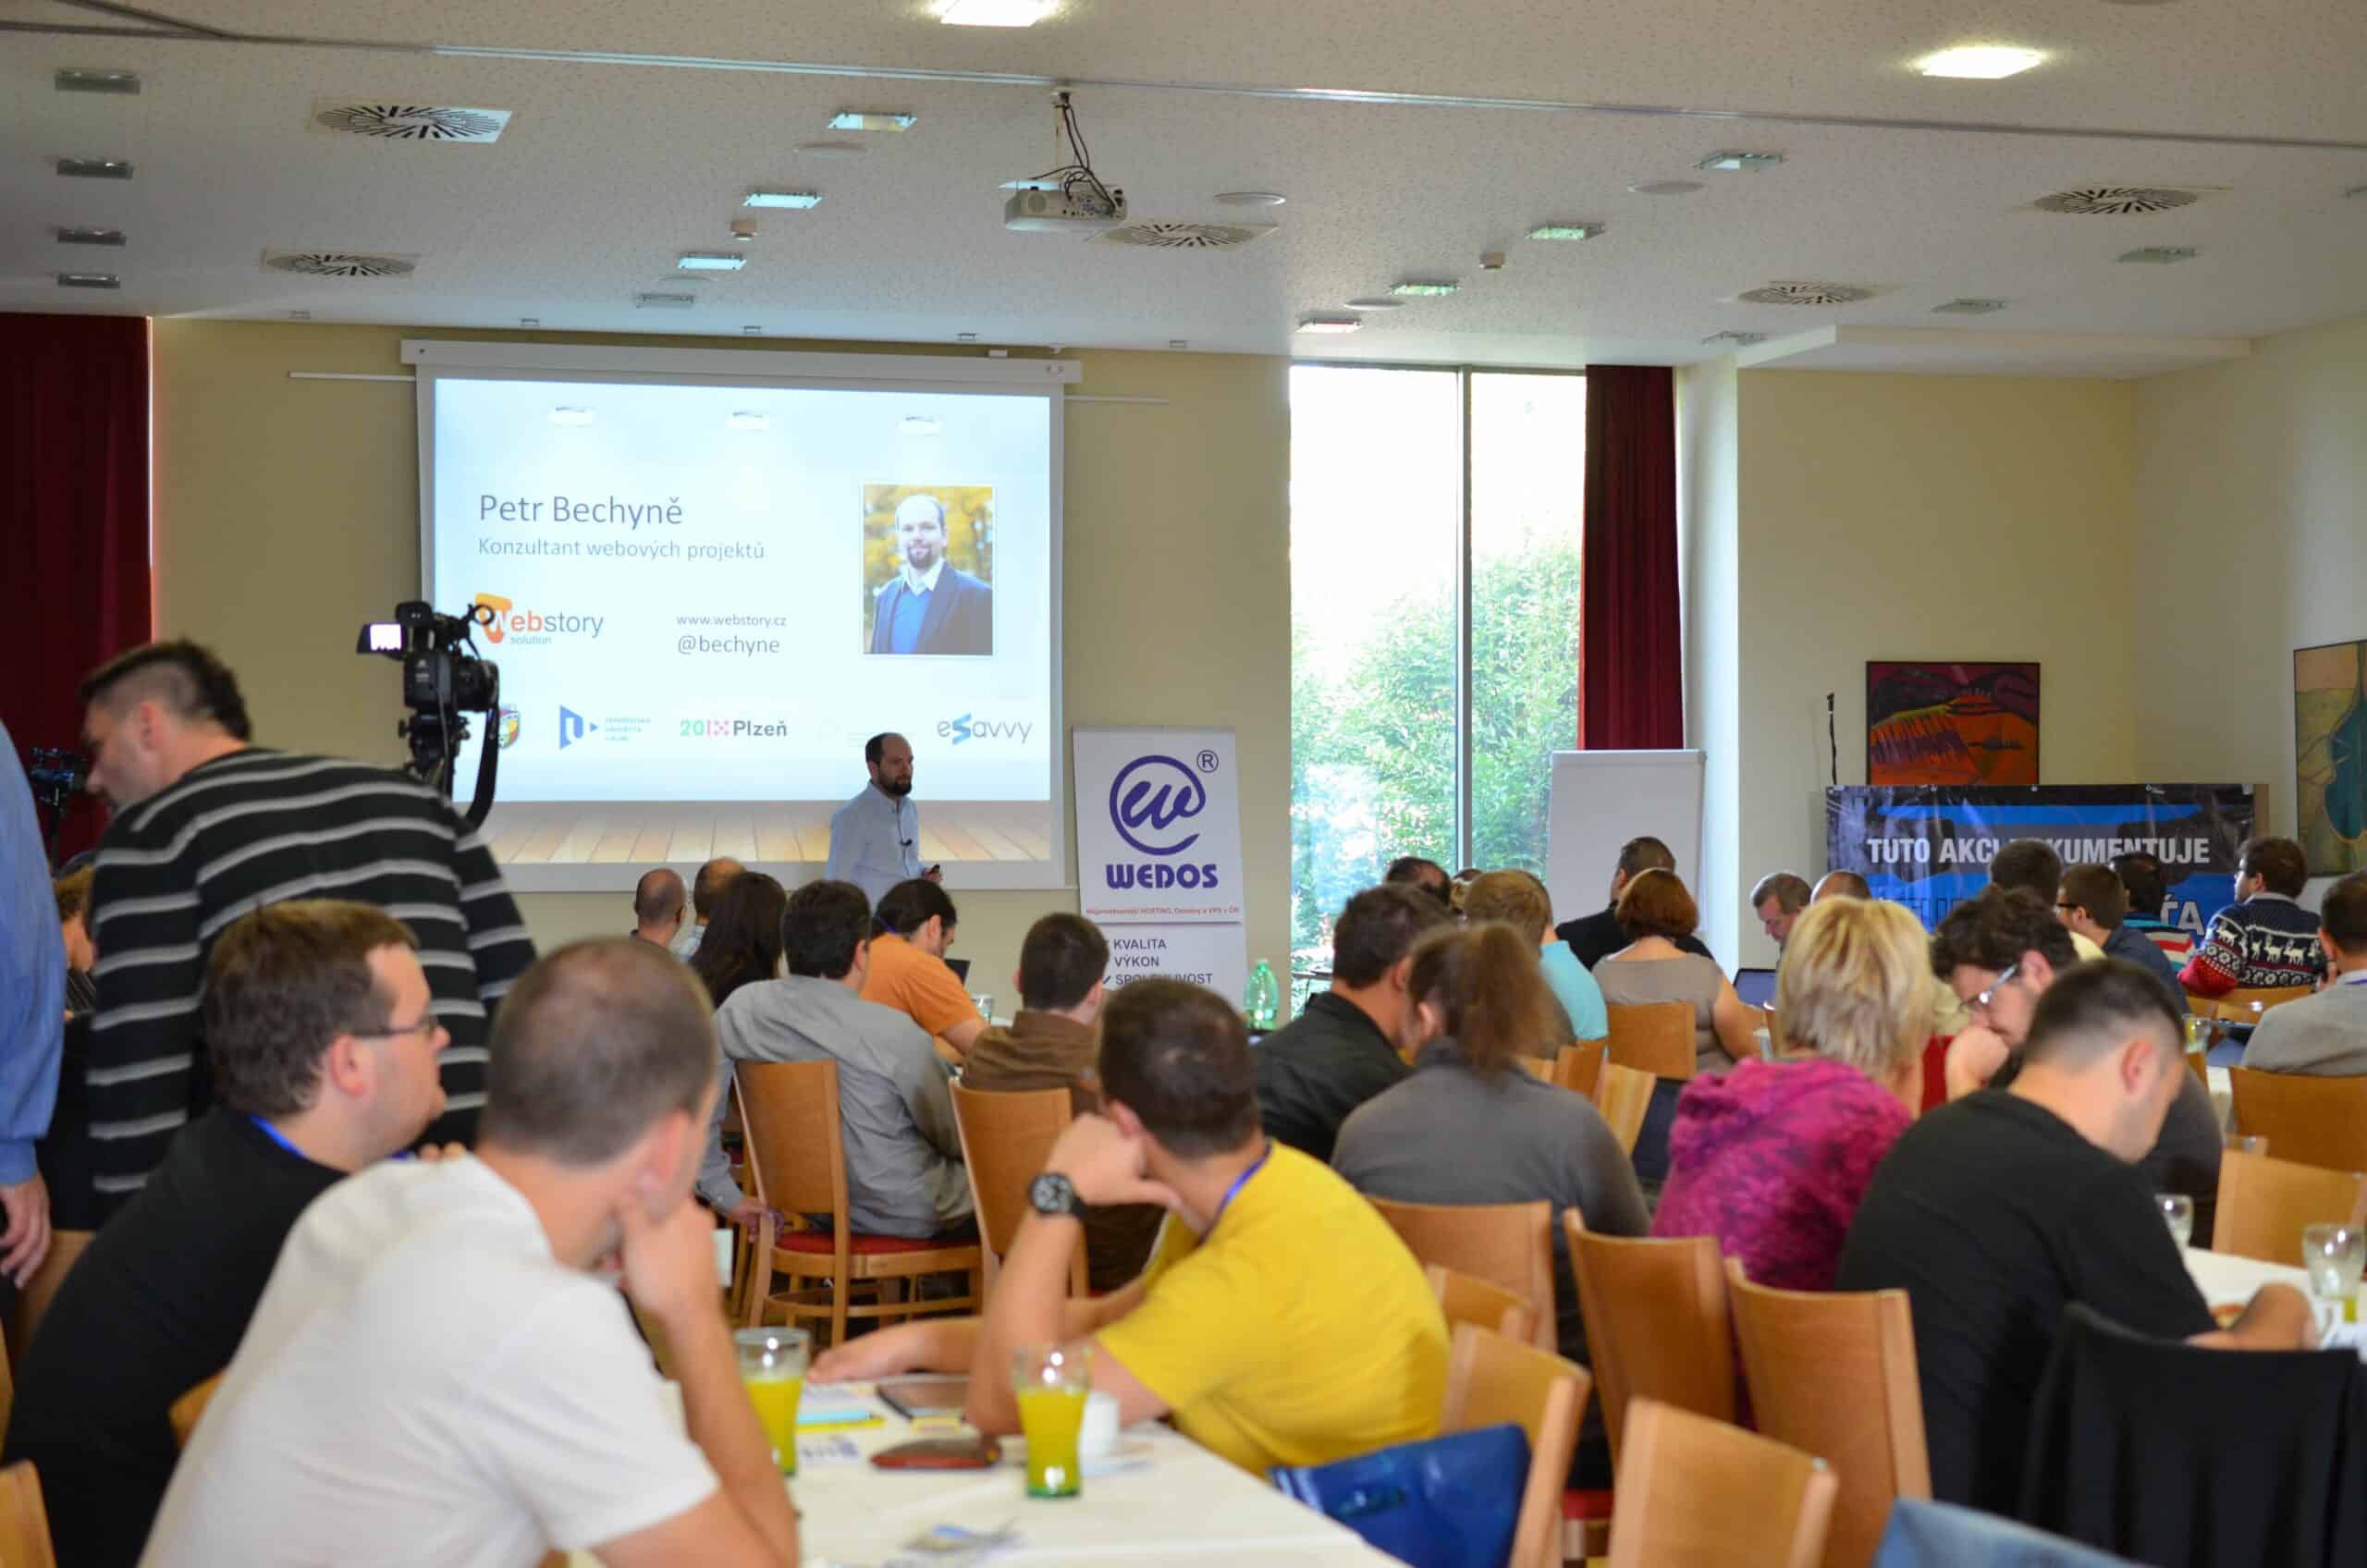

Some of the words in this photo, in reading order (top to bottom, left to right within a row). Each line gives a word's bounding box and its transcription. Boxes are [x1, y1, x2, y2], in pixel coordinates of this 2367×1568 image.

[480, 495, 544, 521] Petr
[553, 496, 682, 530] Bechyně
[478, 538, 581, 556] Konzultant
[586, 539, 681, 560] webových
[687, 541, 765, 562] projektů
[676, 614, 787, 628] www.webstory.cz
[510, 635, 552, 644] solution
[678, 635, 780, 657] @bechyne
[733, 718, 788, 737] Plzeň
[937, 713, 1033, 745] eSavvy
[1866, 838, 1931, 864] TUTO
[2009, 838, 2210, 864] KUMENTUJE
[1106, 864, 1219, 889] WEDOS
[1113, 938, 1168, 950] KVALITA
[1114, 953, 1160, 967] VÝKON
